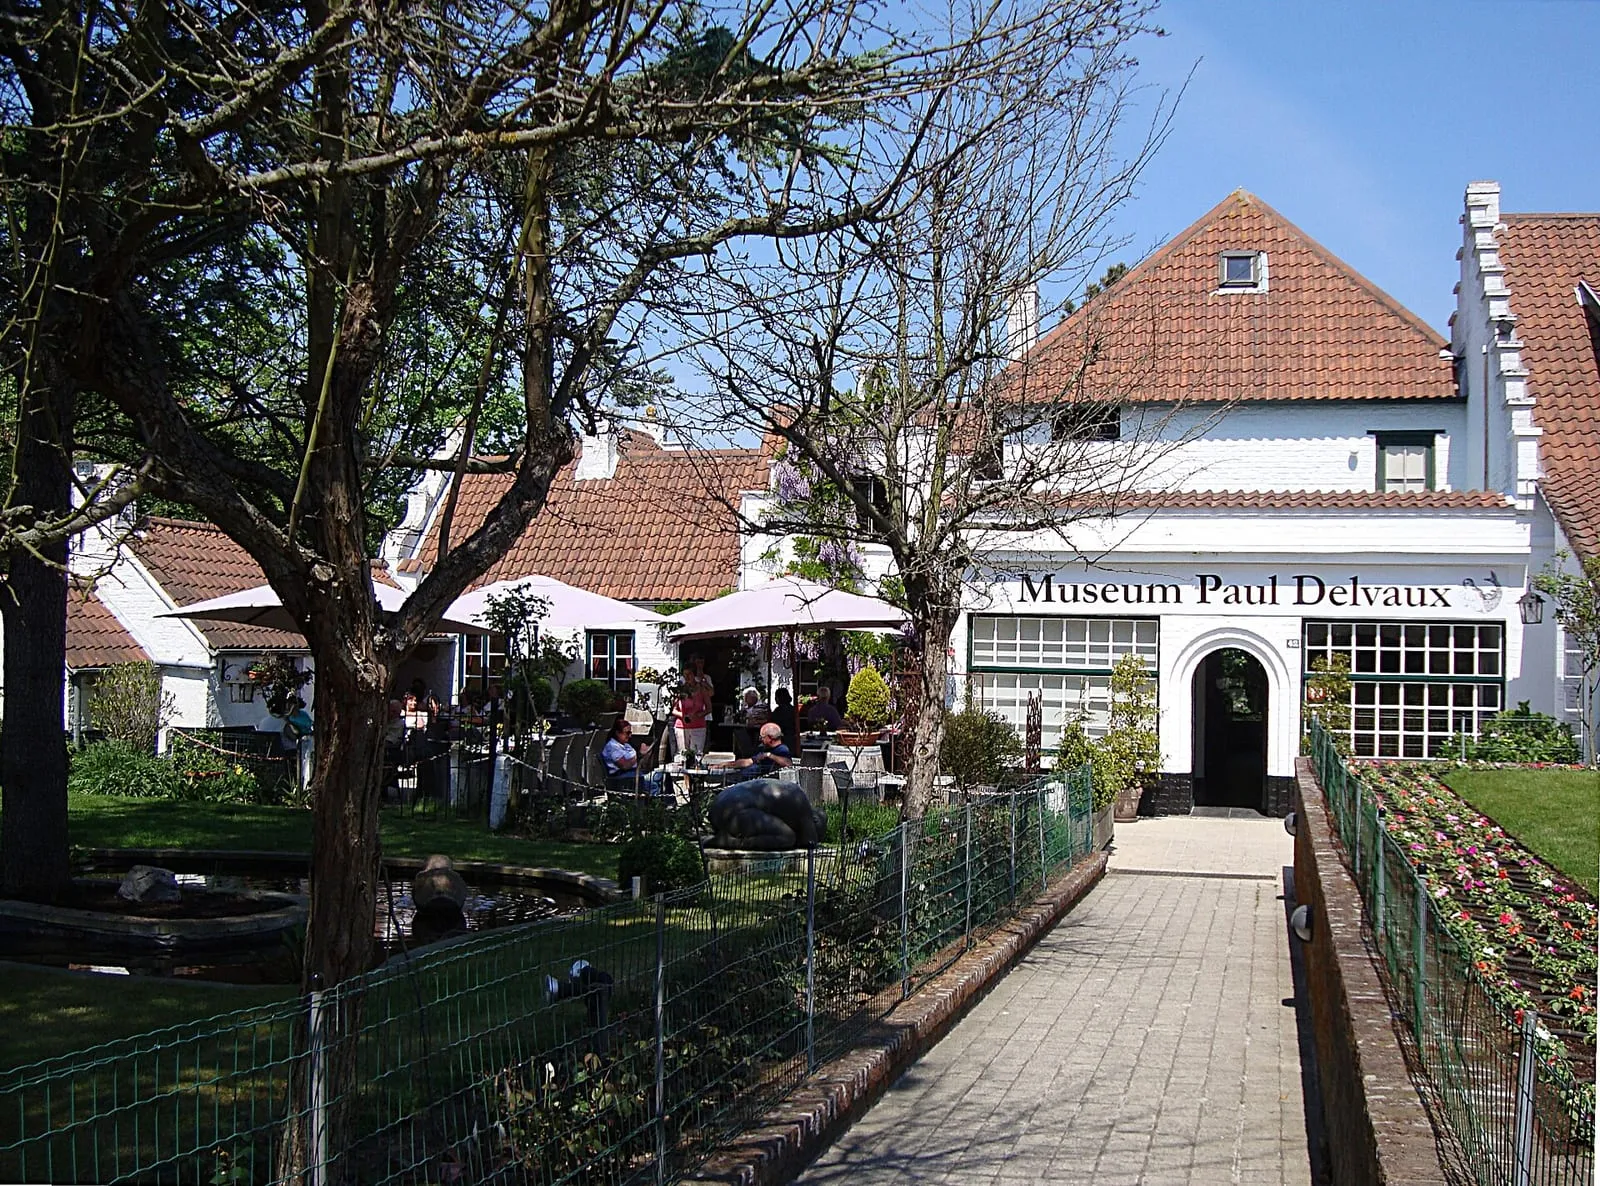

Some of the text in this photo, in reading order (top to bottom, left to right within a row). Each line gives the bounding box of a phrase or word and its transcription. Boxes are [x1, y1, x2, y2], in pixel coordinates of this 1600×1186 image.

[1017, 573, 1452, 608] Museum Paul Delvaux
